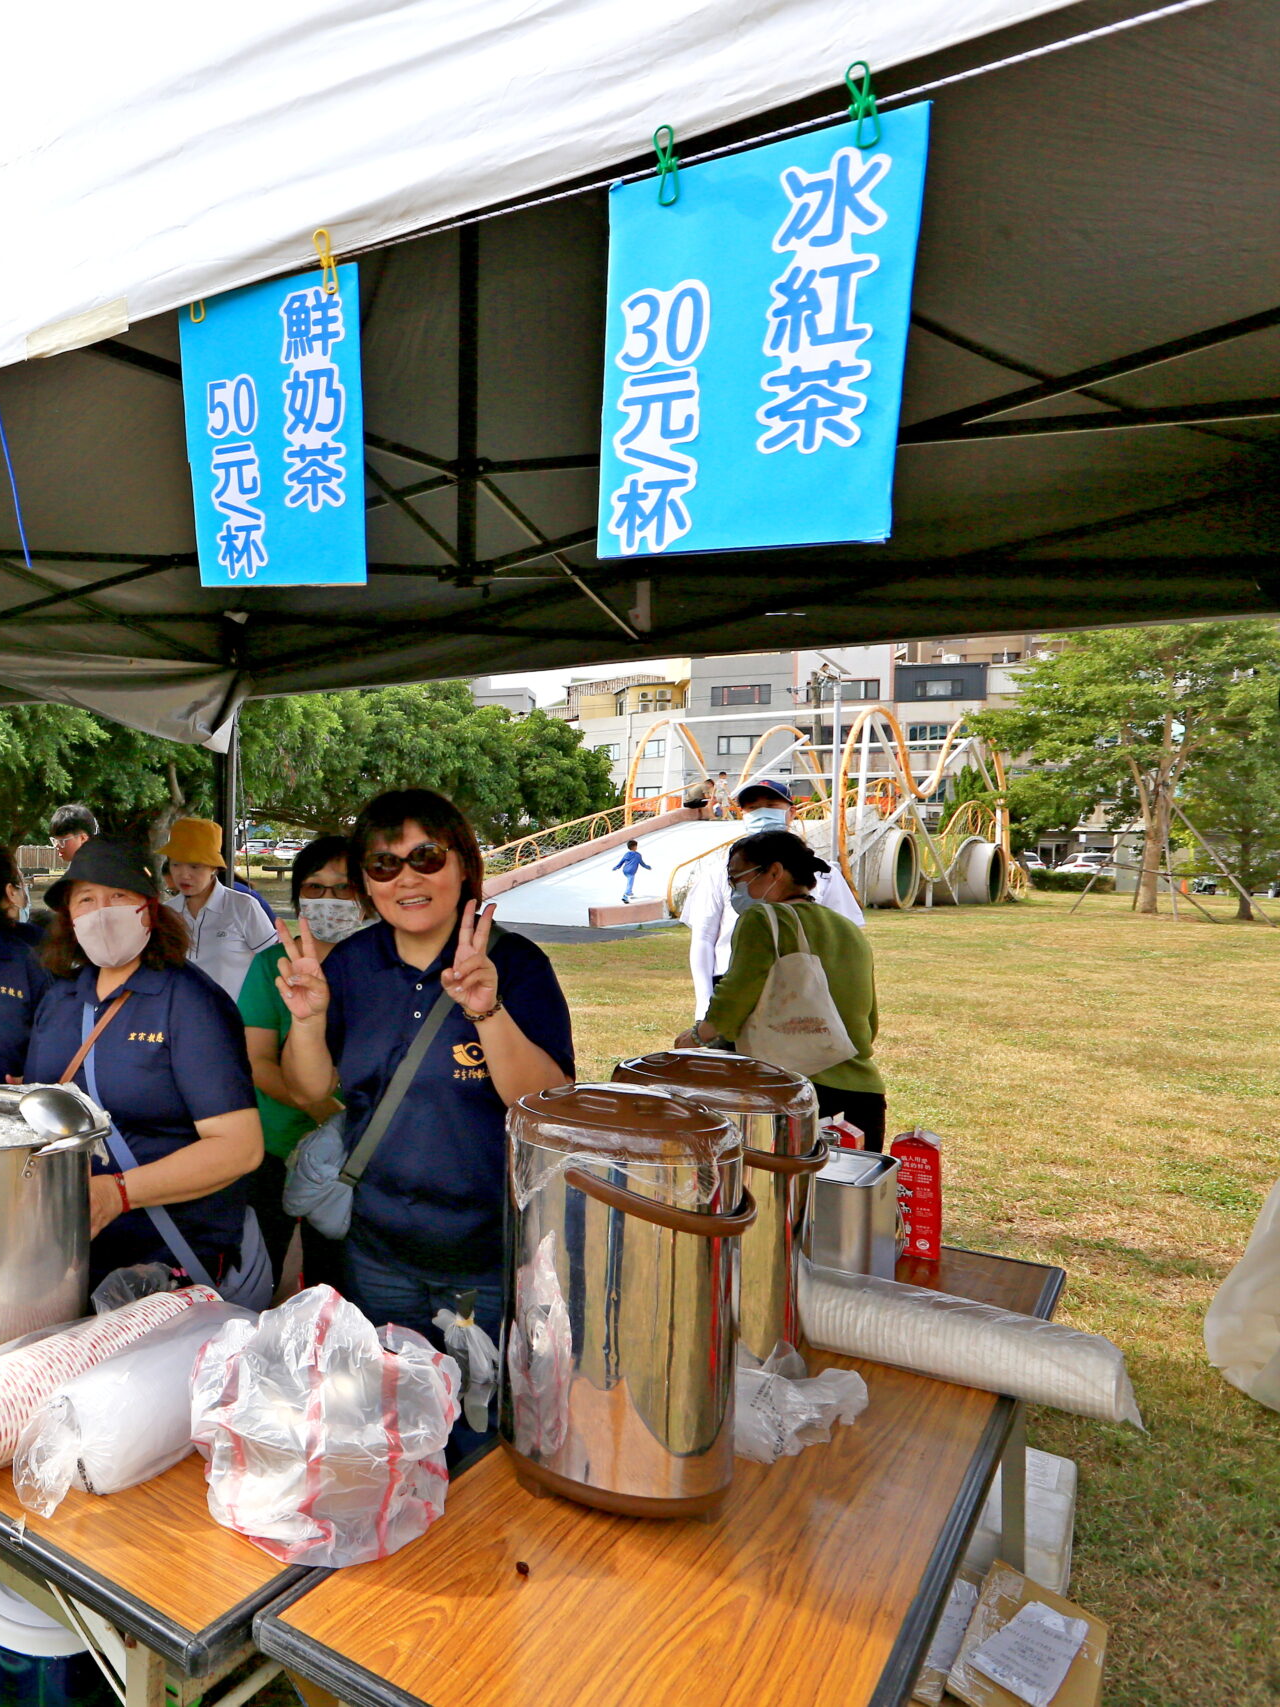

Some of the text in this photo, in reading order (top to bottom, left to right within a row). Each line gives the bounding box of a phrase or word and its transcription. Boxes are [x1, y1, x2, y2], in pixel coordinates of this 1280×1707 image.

[283, 289, 345, 509] 鮮奶茶
[613, 283, 706, 552] 30元/杯
[763, 150, 889, 450] 冰紅茶
[209, 376, 267, 576] 50元/杯
